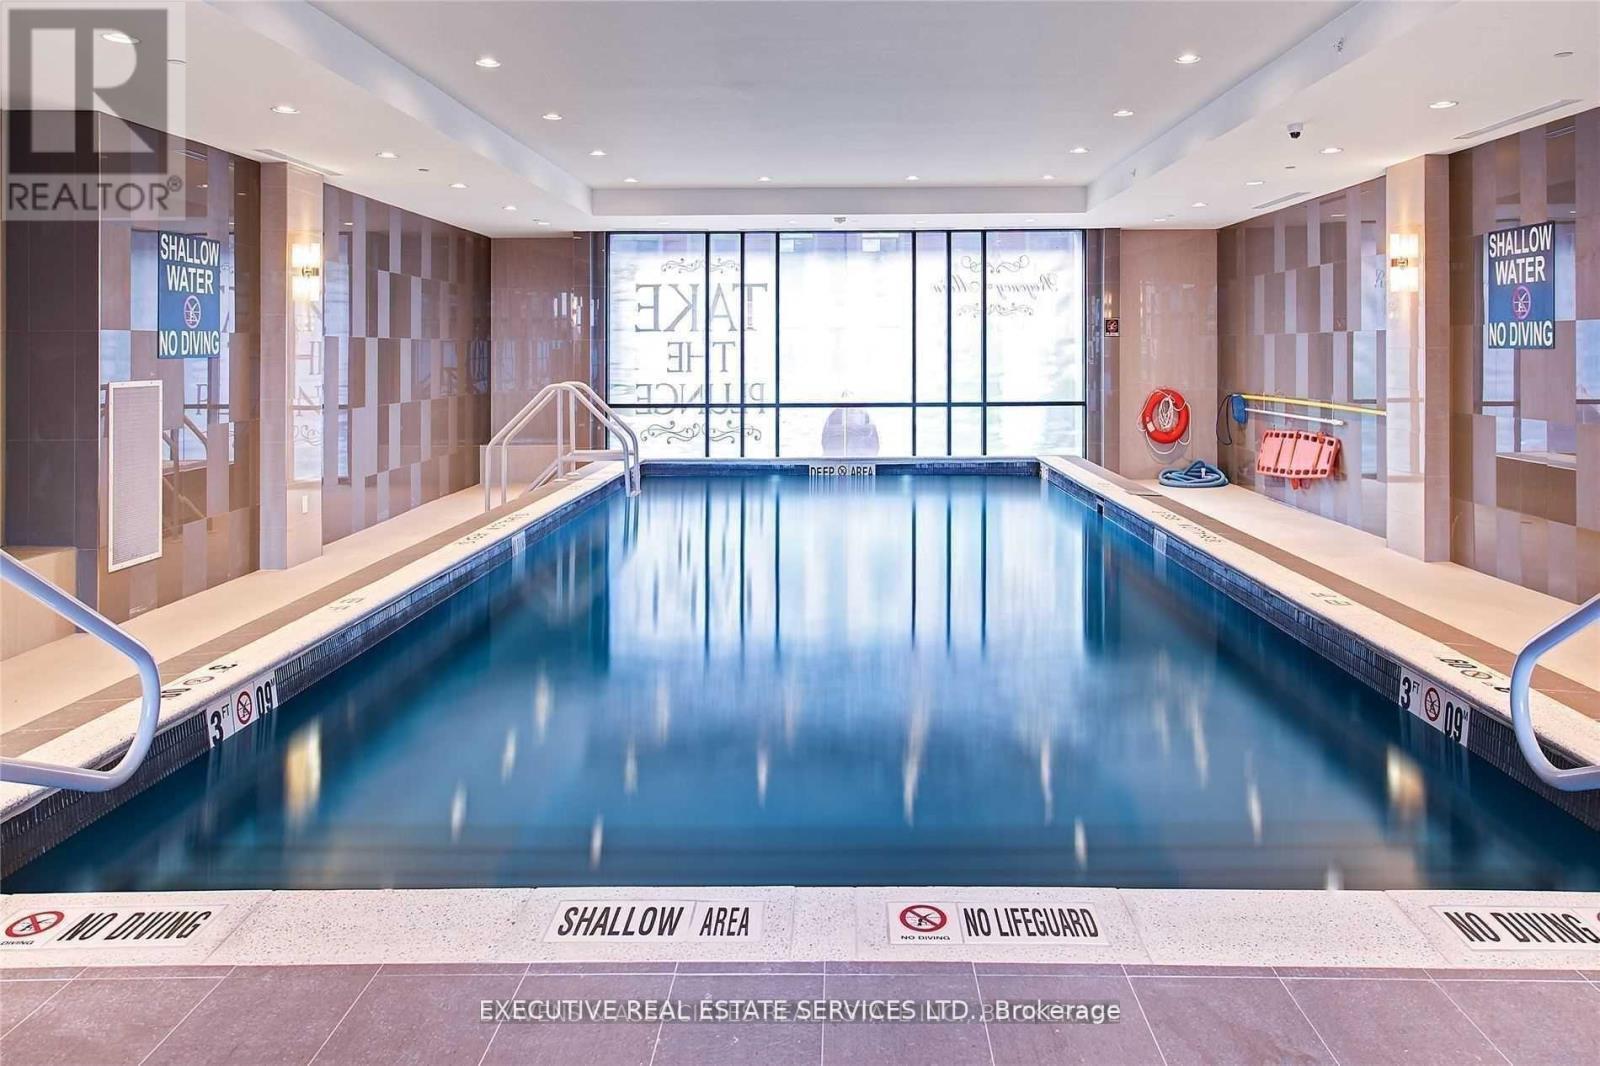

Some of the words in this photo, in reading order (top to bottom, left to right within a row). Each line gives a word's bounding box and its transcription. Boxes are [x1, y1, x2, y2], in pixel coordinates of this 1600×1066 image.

[160, 233, 220, 267] SHALLOW
[1489, 224, 1552, 258] SHALLOW
[166, 264, 214, 294] WATER
[1495, 255, 1546, 286] WATER
[160, 330, 178, 356] NO
[181, 330, 220, 356] DIVING
[1489, 321, 1507, 347] NO
[1509, 320, 1553, 347] DIVING
[851, 466, 873, 476] AREA
[1400, 676, 1412, 709] 3
[210, 710, 224, 746] 3
[57, 912, 118, 941] NO
[103, 911, 212, 940] DIVING
[557, 906, 685, 936] SHALLOW
[699, 906, 750, 936] AREA
[963, 907, 992, 937] NO
[994, 907, 1099, 938] LIFEGUARD
[1443, 911, 1501, 942] NO
[1489, 912, 1600, 943] DIVING
